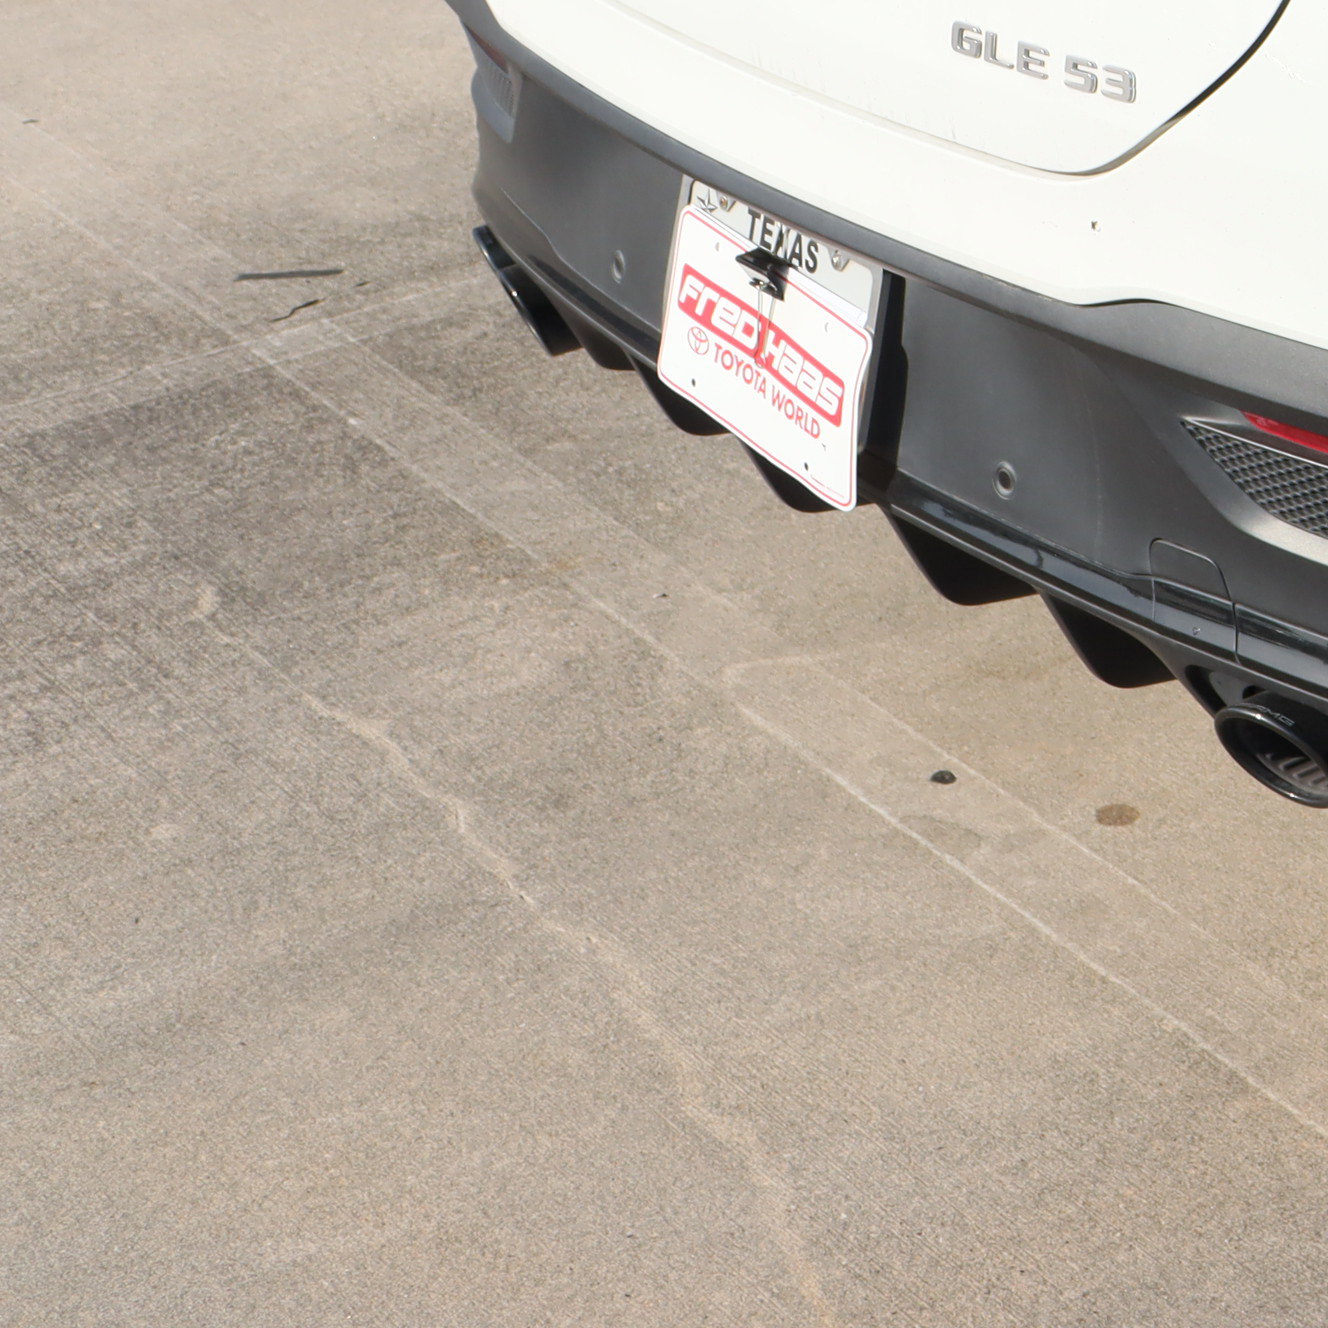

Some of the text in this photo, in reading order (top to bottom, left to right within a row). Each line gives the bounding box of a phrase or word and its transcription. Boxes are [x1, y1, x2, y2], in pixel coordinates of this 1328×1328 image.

[951, 21, 1137, 104] GLE 53
[748, 206, 819, 274] TEXAS
[714, 342, 821, 440] TOYOTA WORLD
